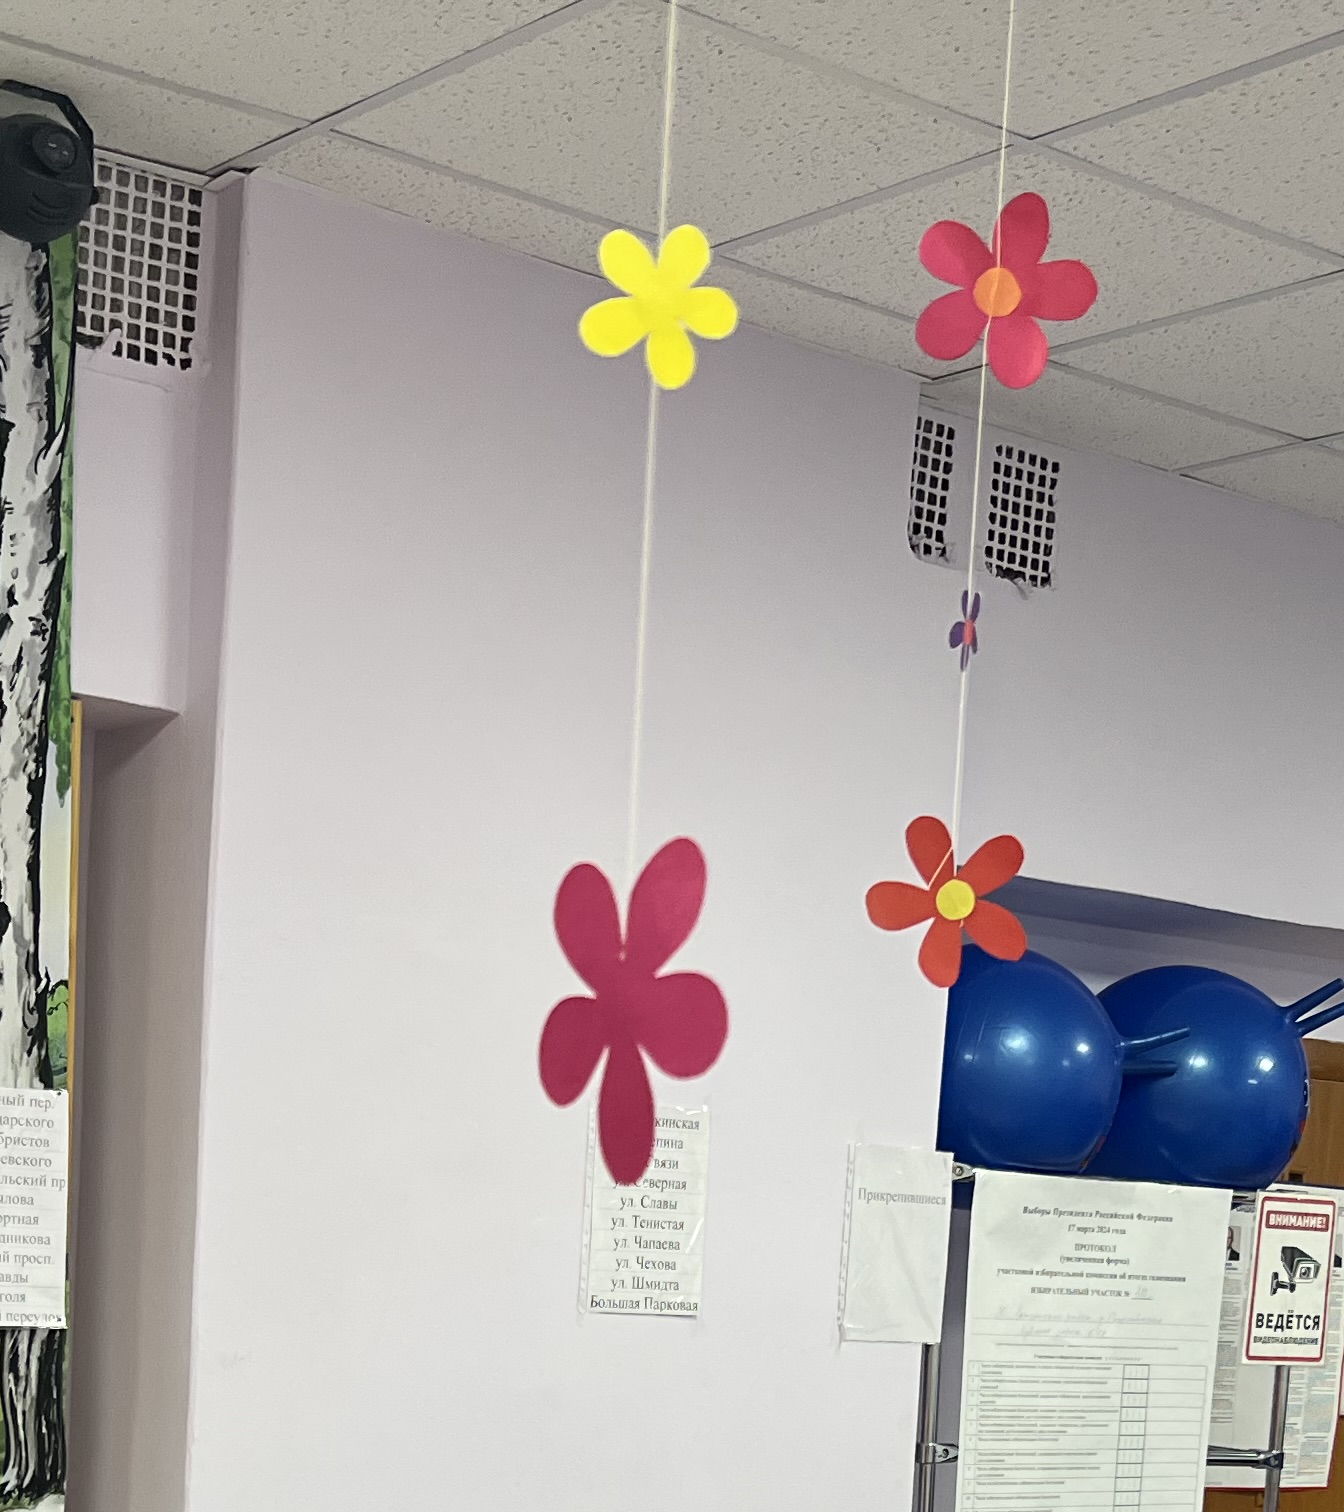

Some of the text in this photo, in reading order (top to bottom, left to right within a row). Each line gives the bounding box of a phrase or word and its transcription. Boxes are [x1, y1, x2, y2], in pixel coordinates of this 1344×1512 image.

[635, 1178, 687, 1192] еверная
[641, 1194, 677, 1210] Славы
[632, 1215, 684, 1231] Тенистая
[1269, 1213, 1326, 1229] ВНИМАНИЕ!
[634, 1235, 680, 1251] Чапаева
[636, 1256, 676, 1271] Чехова
[632, 1275, 679, 1292] Шмидта
[590, 1295, 698, 1312] Большая Парковая
[1256, 1310, 1320, 1332] ВЕДЁТСЯ
